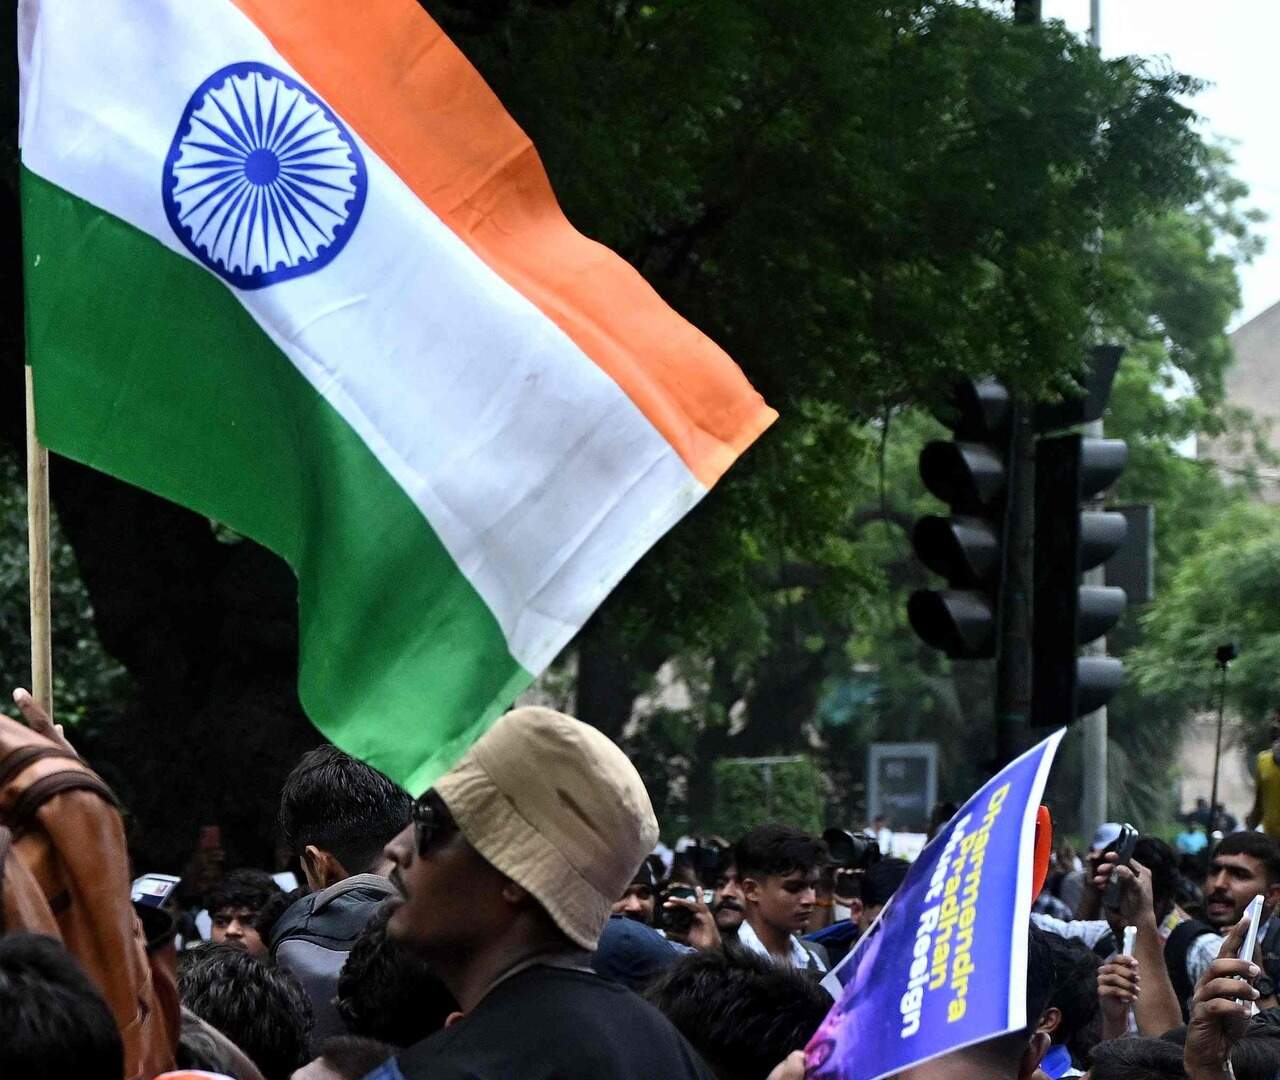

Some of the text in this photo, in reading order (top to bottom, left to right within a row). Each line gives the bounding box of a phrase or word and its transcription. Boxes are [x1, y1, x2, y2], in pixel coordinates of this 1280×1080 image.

[900, 905, 940, 1039] Resign
[928, 829, 978, 991] Pradhan
[947, 782, 1011, 1023] Dharmendra
